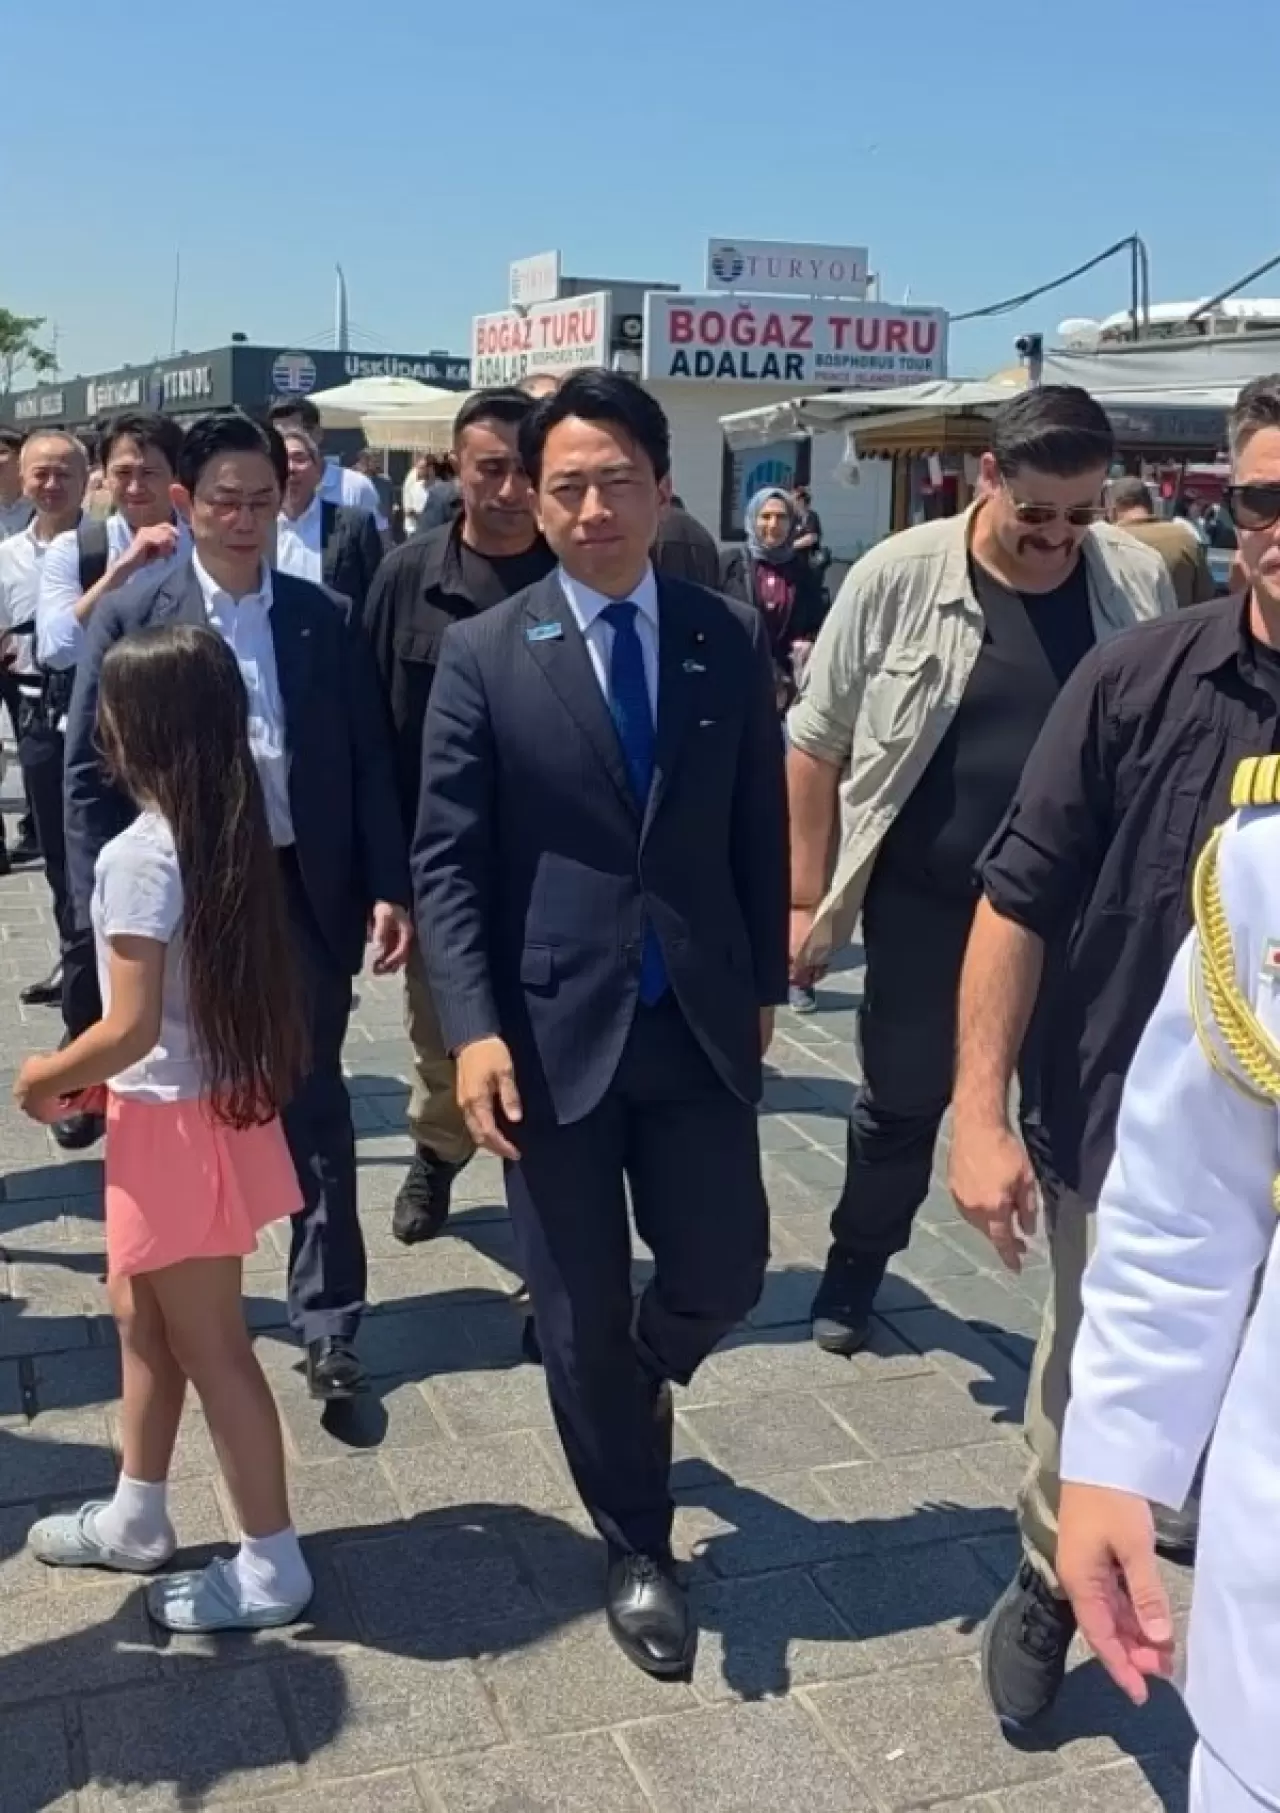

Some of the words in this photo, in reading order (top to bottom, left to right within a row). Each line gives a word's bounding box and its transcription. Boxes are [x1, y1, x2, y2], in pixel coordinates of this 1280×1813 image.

[746, 255, 865, 282] TURYOL
[477, 316, 532, 355] BOĞAZ
[540, 308, 596, 348] TURU
[669, 301, 813, 350] BOĞAZ
[827, 316, 937, 355] TURU
[668, 349, 805, 381] ADALAR
[815, 353, 894, 369] BOSPHORUS
[899, 357, 932, 371] TOUR
